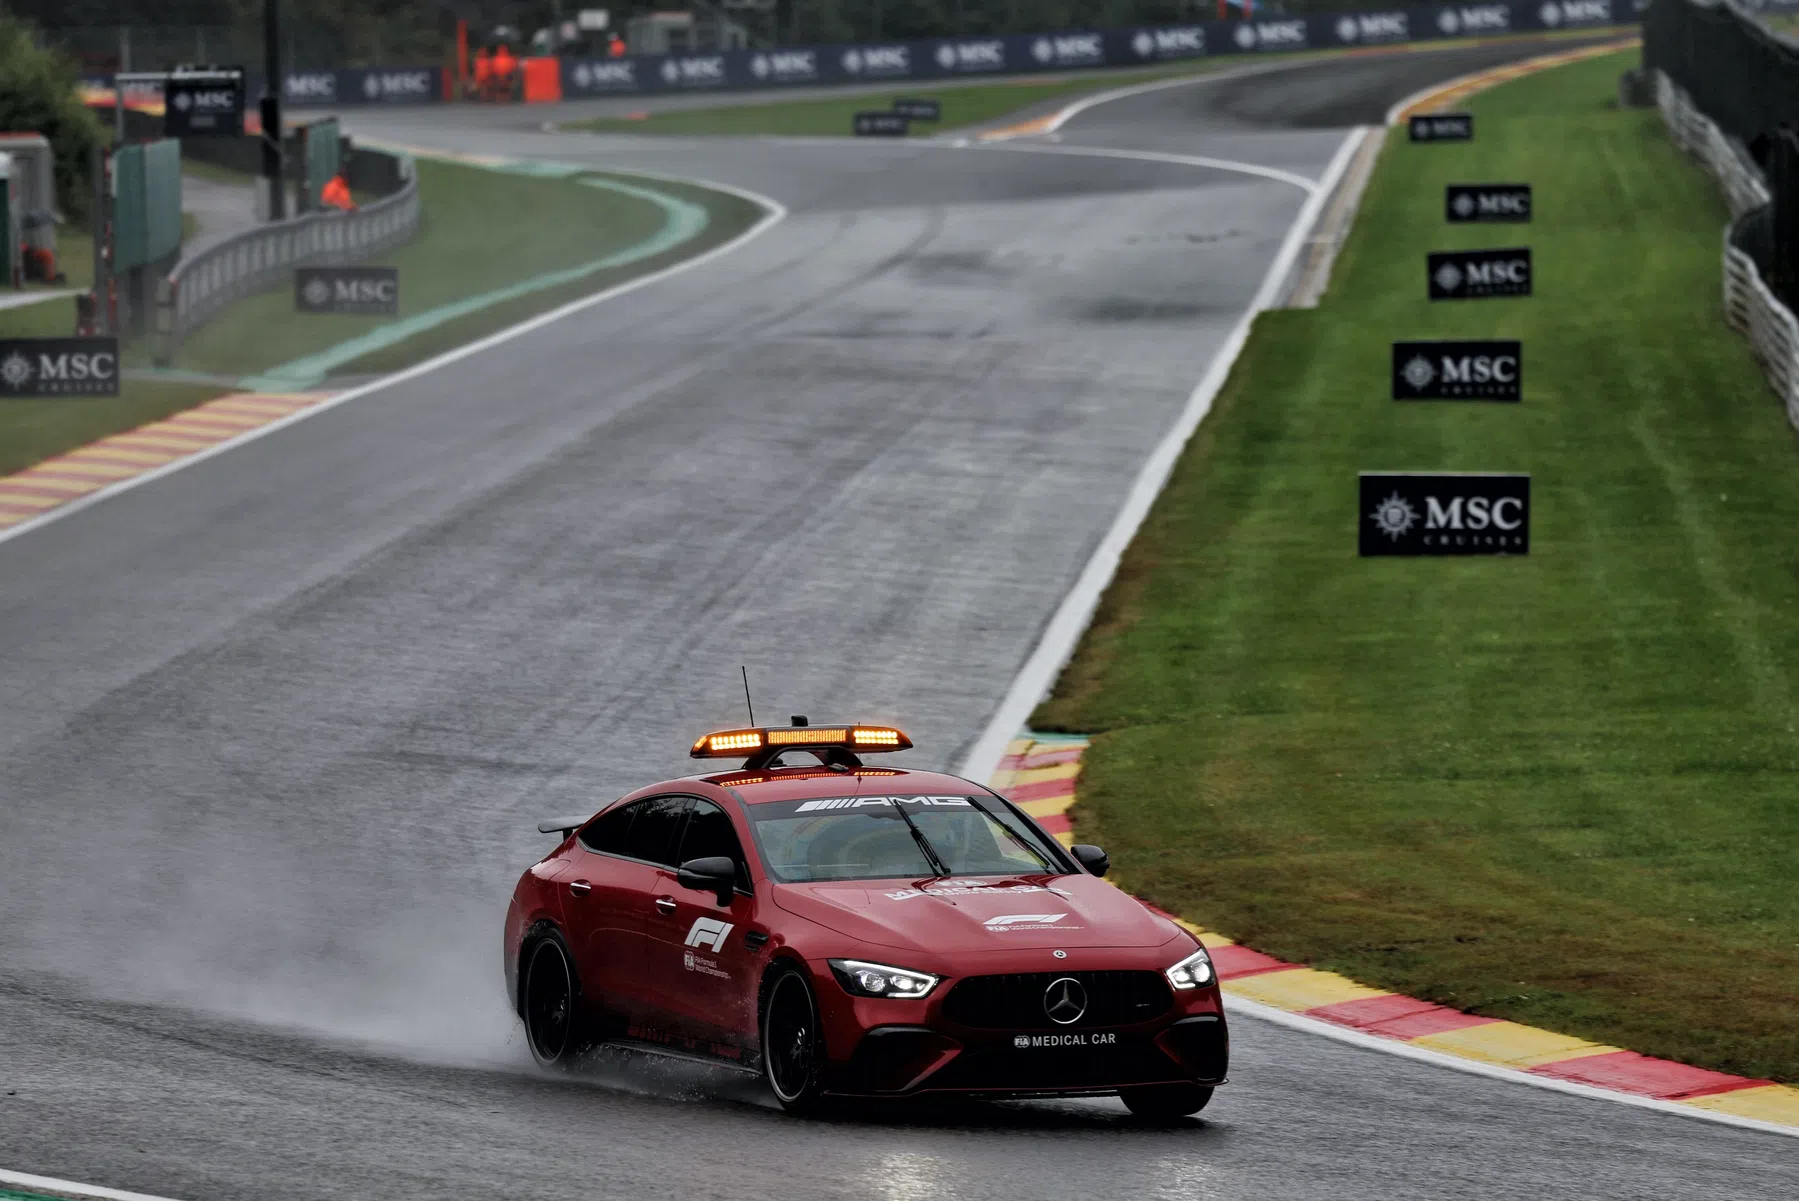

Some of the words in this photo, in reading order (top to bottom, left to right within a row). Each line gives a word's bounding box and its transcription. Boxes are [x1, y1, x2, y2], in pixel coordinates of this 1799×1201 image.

[1479, 192, 1528, 213] MSC
[1465, 259, 1527, 285] MSC
[335, 278, 393, 301] MSC
[38, 353, 114, 379] MSC
[1440, 355, 1516, 383] MSC
[1424, 496, 1522, 530] MSC
[851, 796, 972, 808] AMG
[1014, 1037, 1030, 1046] FIA
[1032, 1035, 1087, 1047] MEDICAL
[1091, 1033, 1116, 1044] CAR
